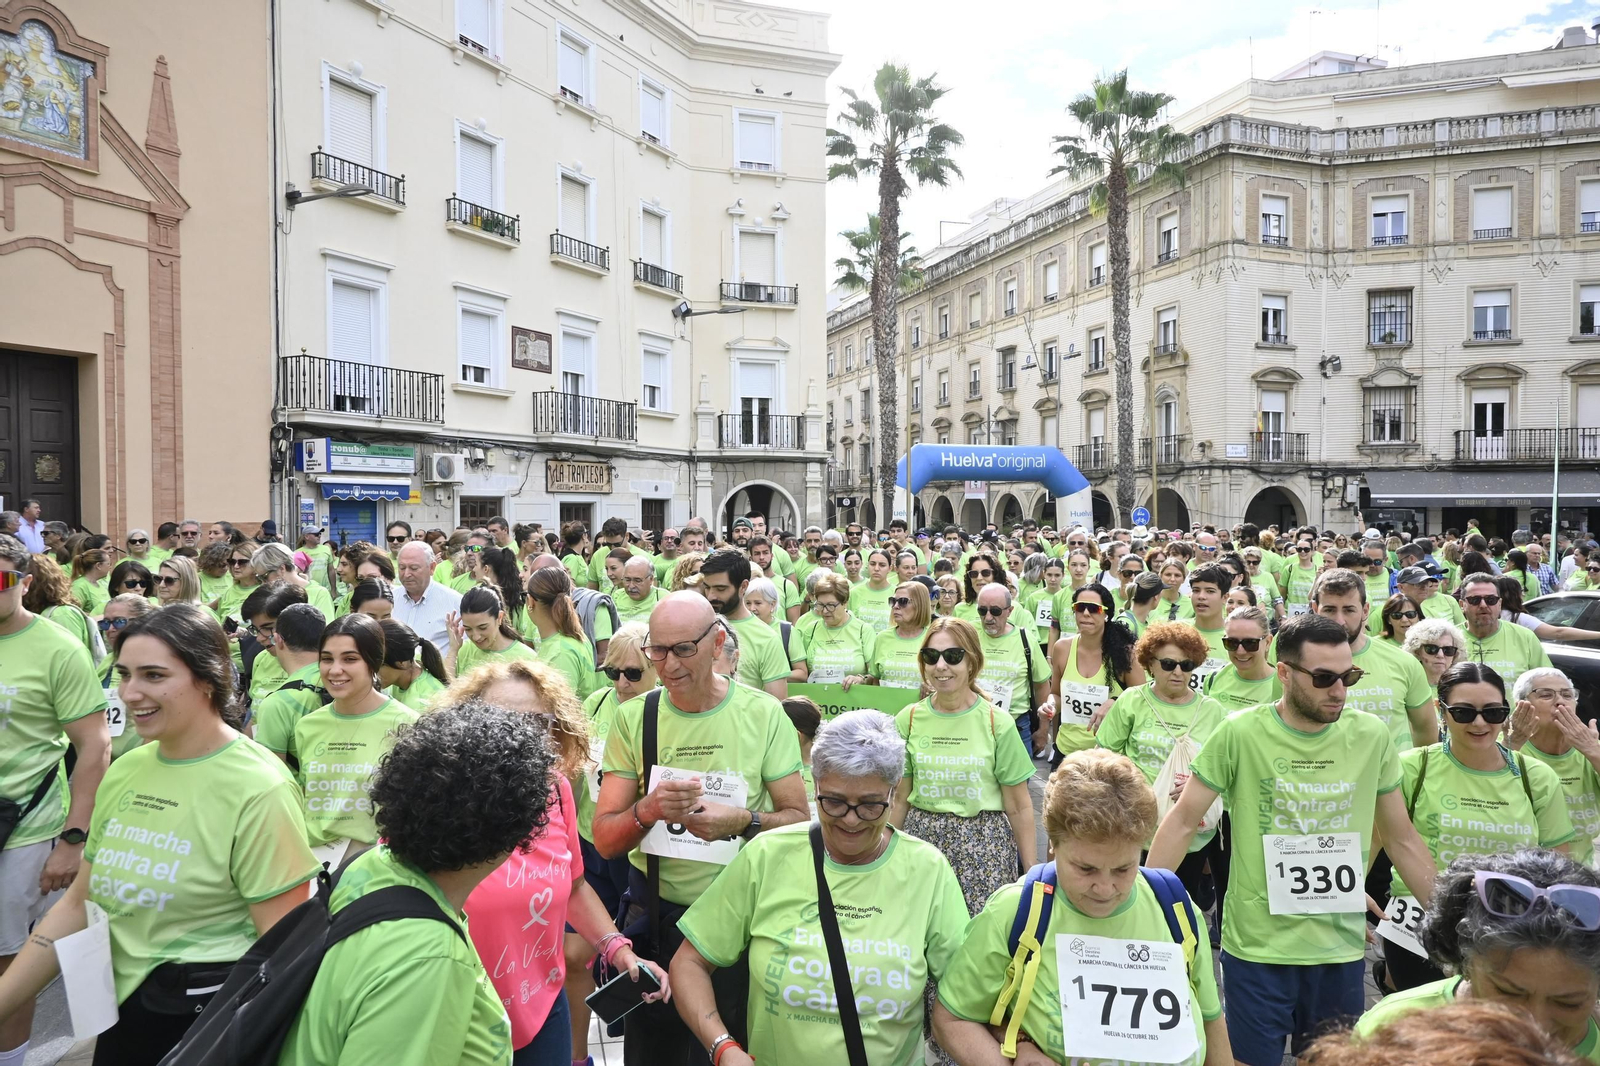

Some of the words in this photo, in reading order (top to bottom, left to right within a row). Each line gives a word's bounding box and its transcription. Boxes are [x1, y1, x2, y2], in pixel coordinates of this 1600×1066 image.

[942, 452, 993, 468] Huelva
[998, 454, 1046, 471] original
[556, 464, 564, 482] LA
[567, 465, 604, 484] TRAVIESA
[1065, 695, 1102, 716] 285
[1379, 698, 1393, 710] el
[308, 760, 326, 774] En
[332, 761, 374, 774] march
[916, 752, 932, 764] En
[936, 754, 985, 766] marcha
[307, 778, 358, 792] contra
[918, 768, 967, 782] contra
[920, 782, 983, 800] cáncer
[1275, 778, 1294, 793] En
[1298, 779, 1356, 794] marcha
[308, 792, 369, 812] cánce
[1259, 777, 1274, 836] HUELVA
[1274, 798, 1337, 812] contra
[1339, 794, 1352, 810] el
[1274, 812, 1352, 834] cáncer
[1440, 813, 1462, 829] En
[1468, 818, 1532, 836] marcha
[105, 818, 122, 838] En
[124, 825, 192, 856] marcha
[1427, 812, 1439, 864] UELVA
[1439, 834, 1509, 852] contra
[94, 848, 152, 876] contra
[152, 860, 180, 884] el
[506, 853, 569, 888] Unidos
[1275, 862, 1356, 894] 1330
[834, 904, 857, 912] ciación
[858, 906, 882, 914] española
[794, 928, 822, 948] En
[494, 944, 515, 979] La
[1102, 960, 1118, 968] CONTRA
[765, 928, 794, 1016] HUELVA
[886, 964, 911, 990] el
[1072, 975, 1181, 1031] 1779
[794, 1014, 827, 1024] MARCHA
